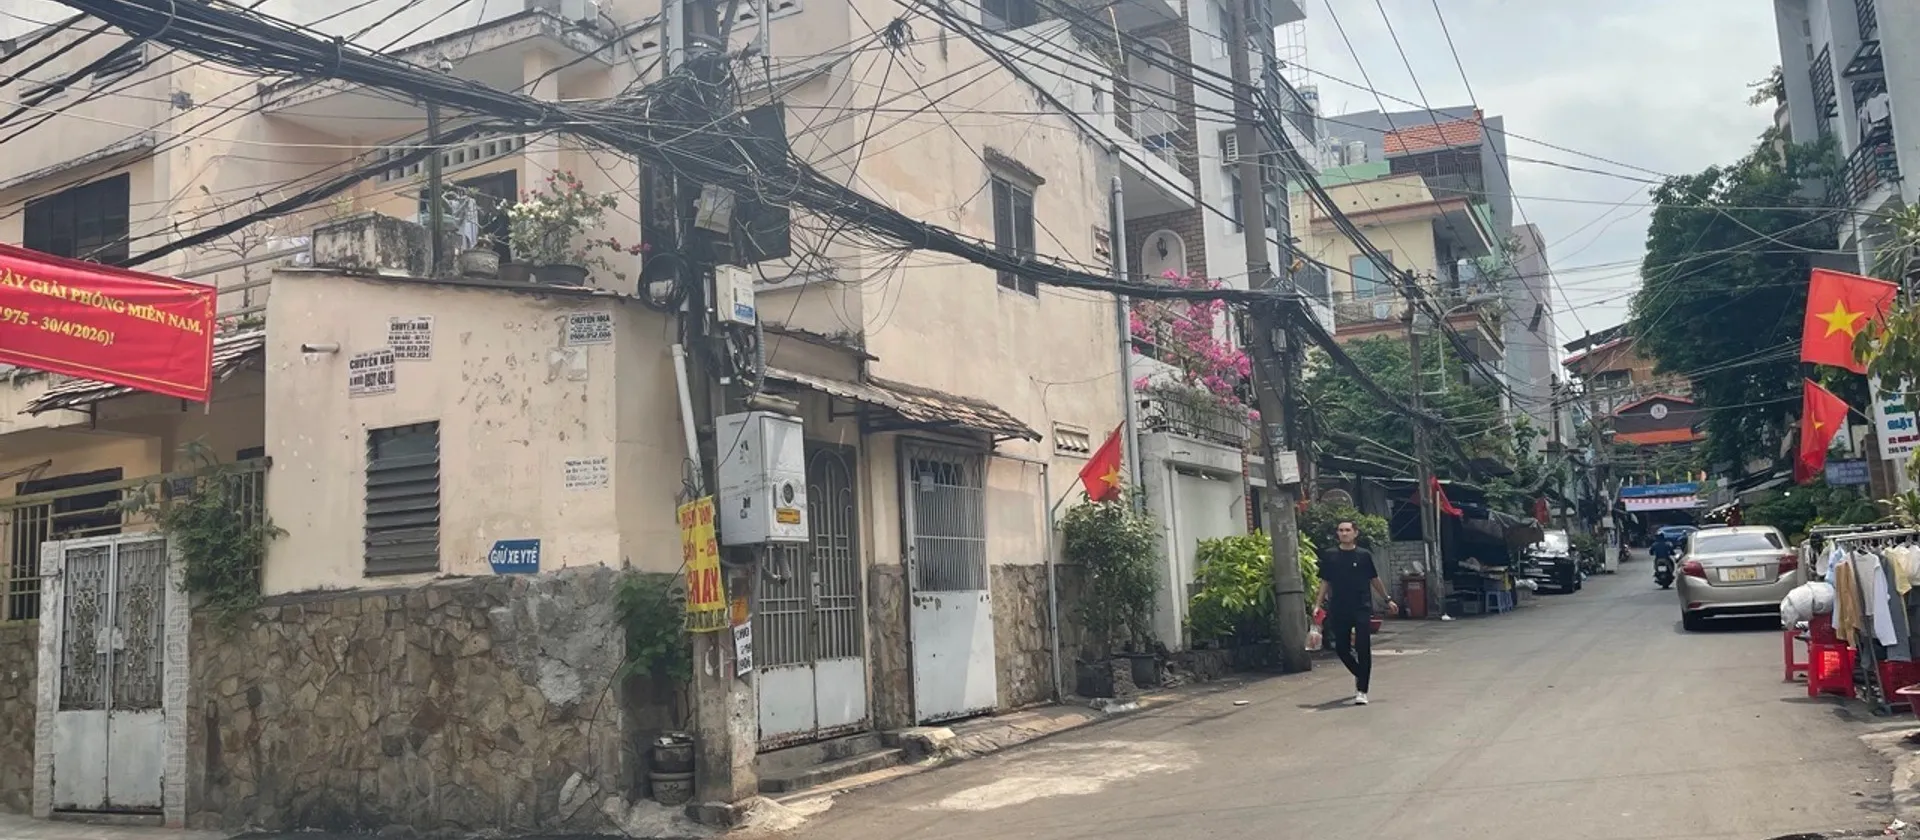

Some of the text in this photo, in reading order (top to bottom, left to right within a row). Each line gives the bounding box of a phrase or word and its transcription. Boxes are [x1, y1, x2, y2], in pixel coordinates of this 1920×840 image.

[0, 267, 27, 289] ÀY
[29, 279, 67, 299] GIẢI
[71, 288, 125, 314] PHÓNG
[168, 313, 203, 337] NAM,
[40, 316, 115, 346] 30/4/2026)!
[507, 549, 519, 564] XE
